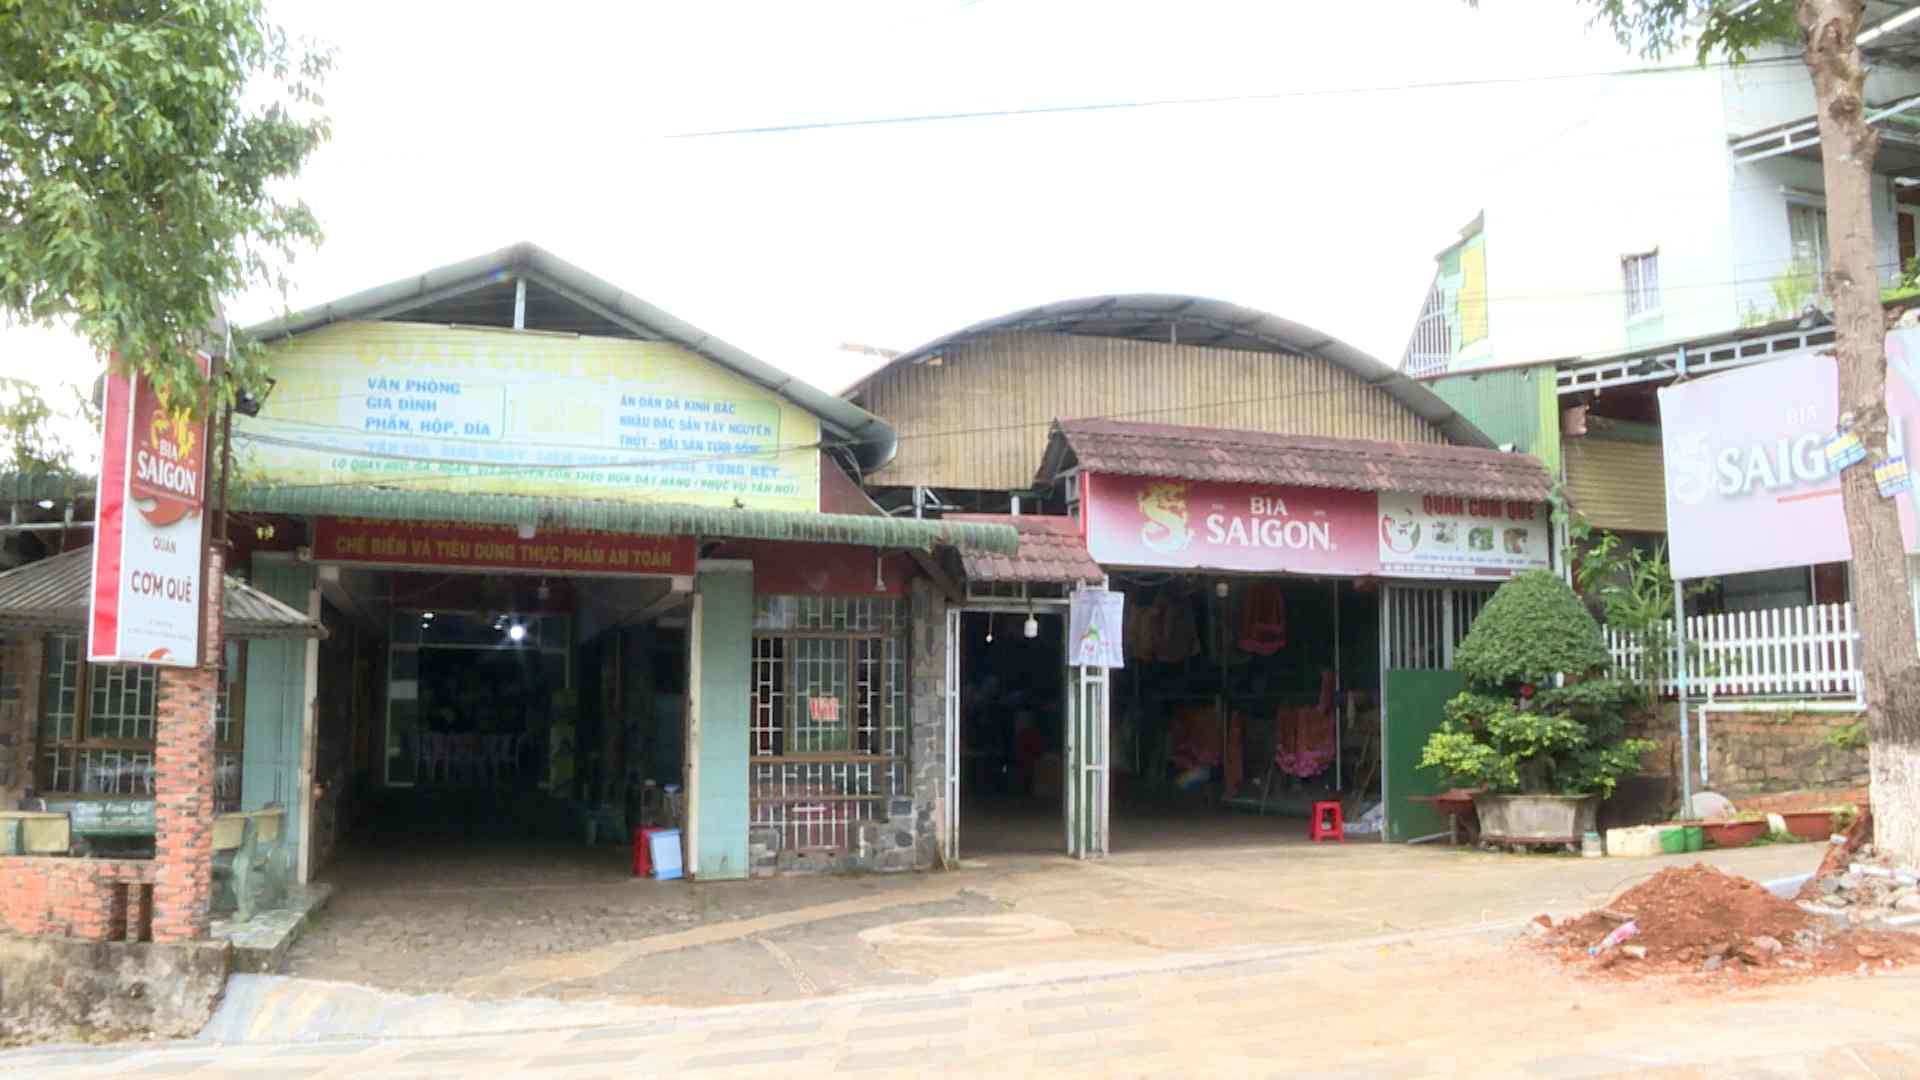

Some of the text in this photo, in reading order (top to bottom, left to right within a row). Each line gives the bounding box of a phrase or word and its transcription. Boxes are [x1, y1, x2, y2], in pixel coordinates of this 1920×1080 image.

[368, 375, 462, 396] VĂN PHÒNG
[366, 397, 392, 410] GIA
[159, 439, 178, 459] BIA
[137, 451, 197, 496] SAIGON
[1250, 496, 1288, 516] BIA
[1206, 513, 1330, 551] SAIGON
[609, 548, 631, 565] AN
[131, 569, 163, 597] CƠM
